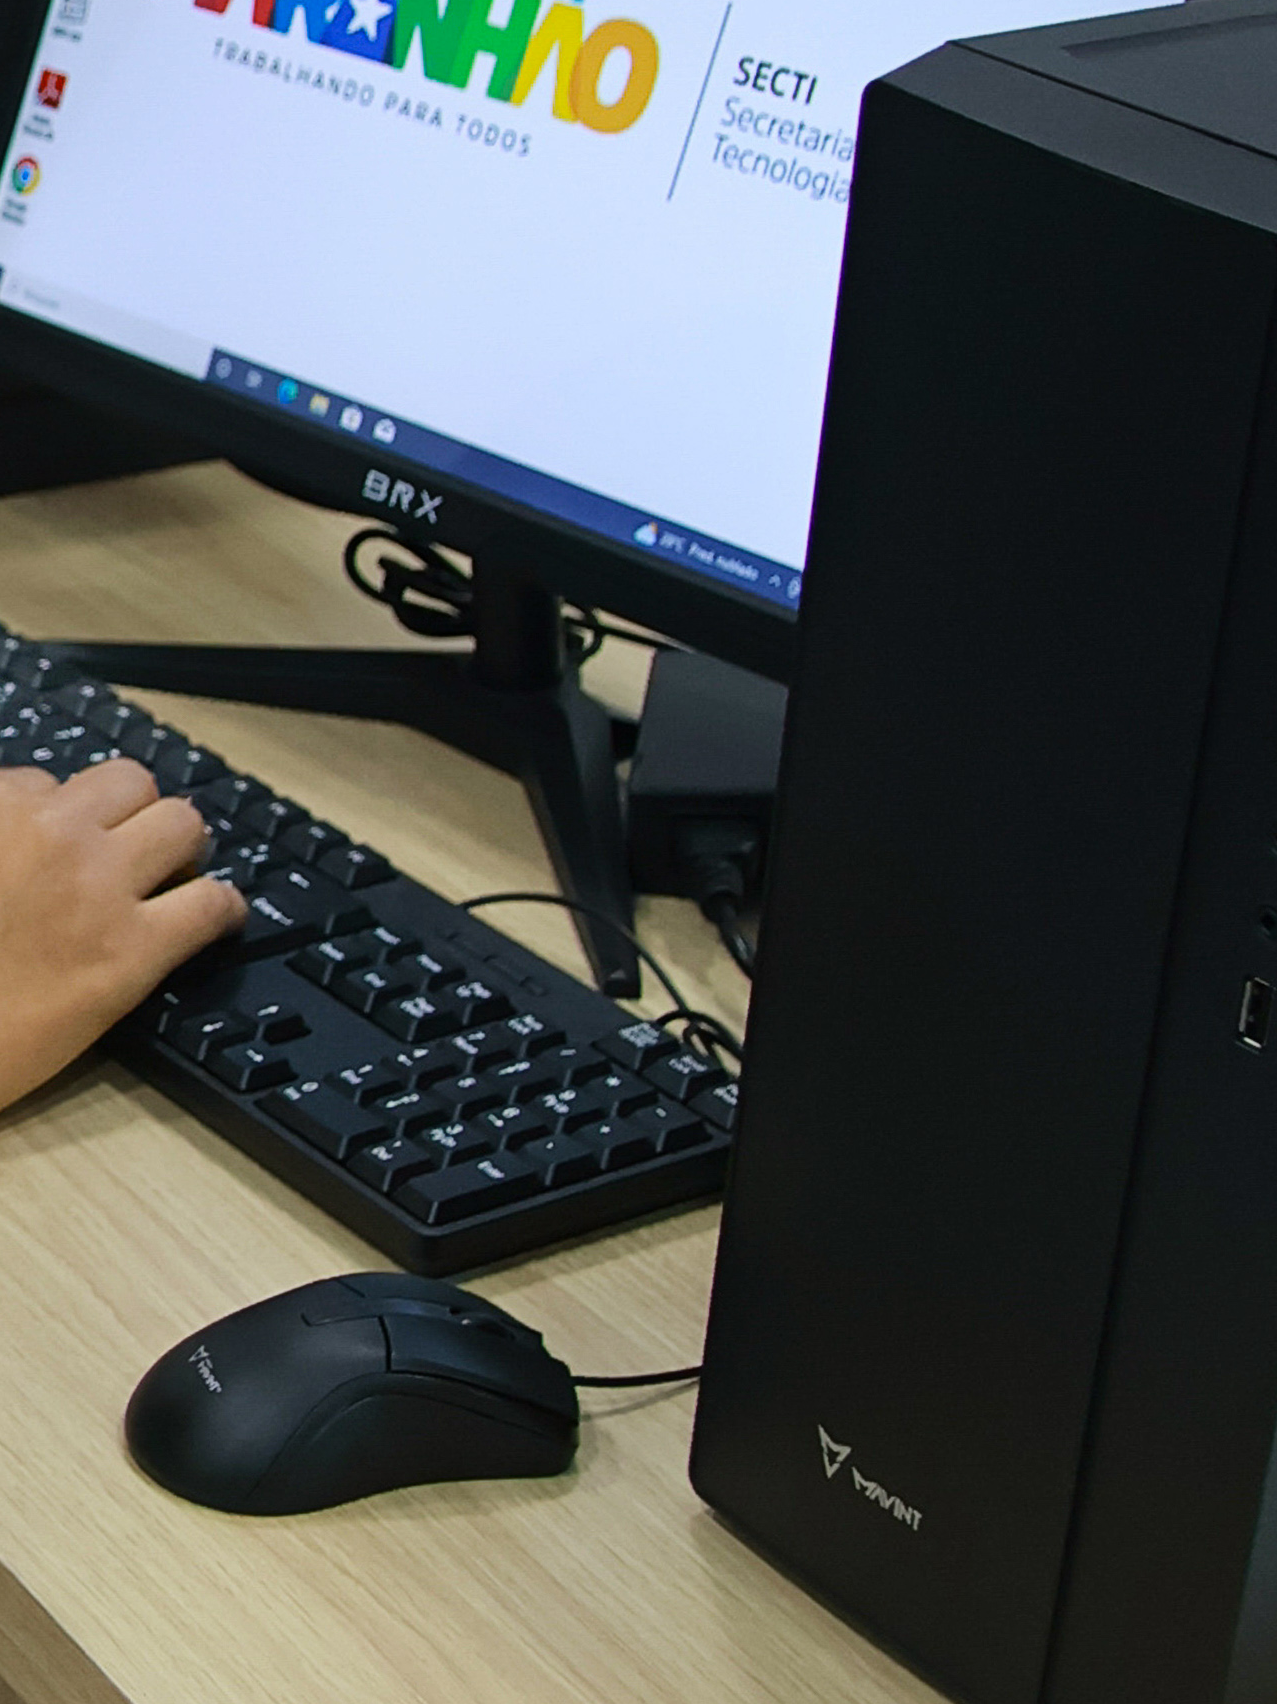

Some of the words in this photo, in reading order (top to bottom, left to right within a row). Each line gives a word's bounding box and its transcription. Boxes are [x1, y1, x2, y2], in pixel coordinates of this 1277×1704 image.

[212, 37, 375, 107] TRABALHANDO
[383, 91, 444, 128] PARA
[456, 113, 532, 157] TODOS
[733, 55, 819, 105] SECTI
[720, 96, 856, 162] Secretaria
[712, 132, 851, 204] Tecnologia
[361, 468, 444, 525] BRX
